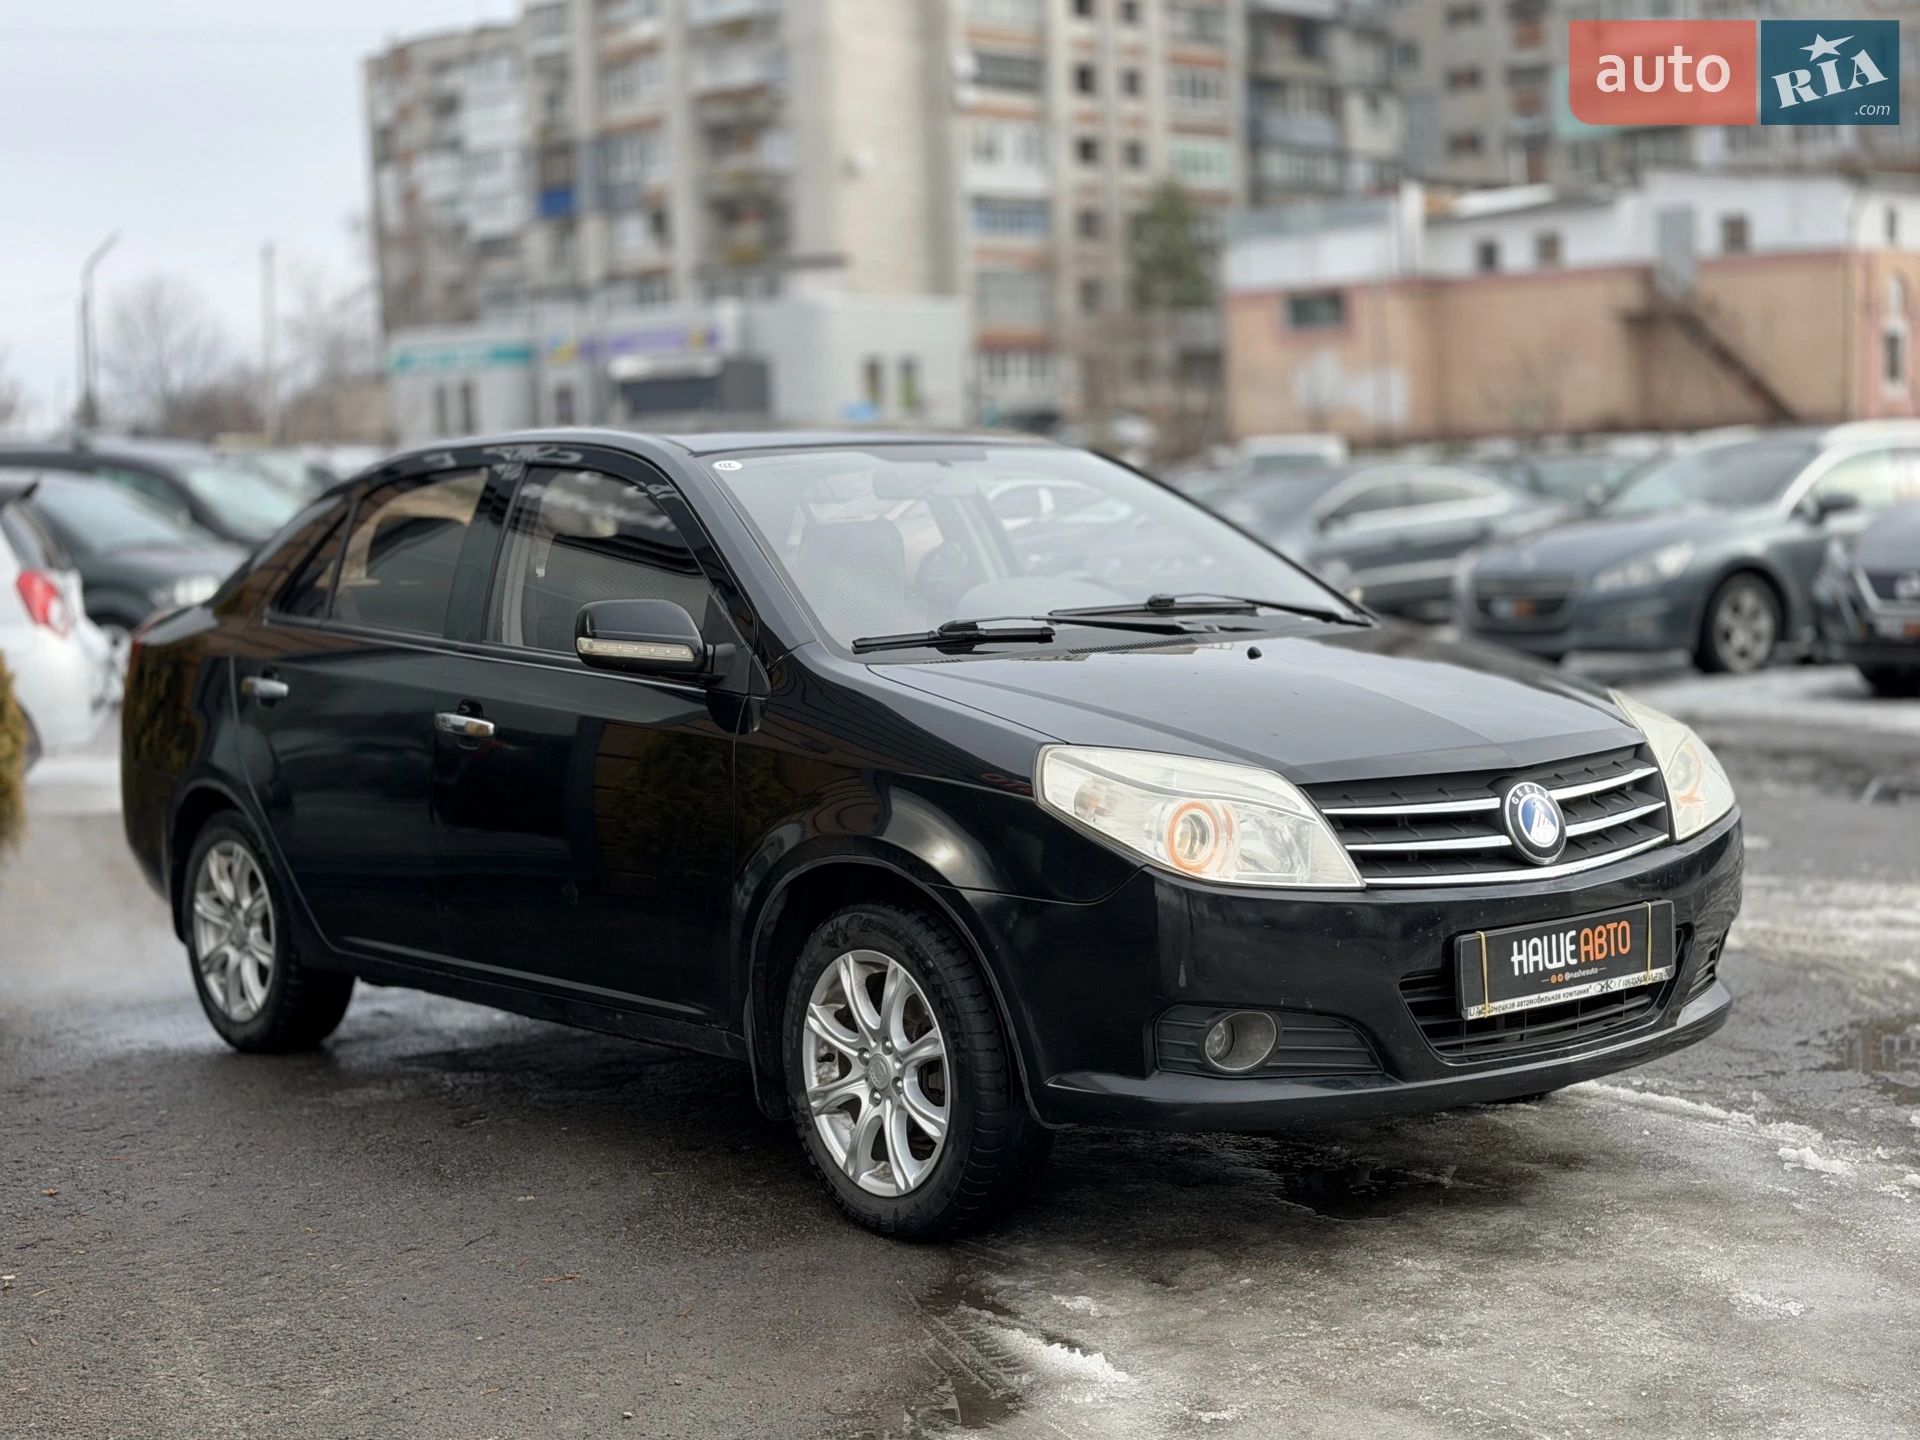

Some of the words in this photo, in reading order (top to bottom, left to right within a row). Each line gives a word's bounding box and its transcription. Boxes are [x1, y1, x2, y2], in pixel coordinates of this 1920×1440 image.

[1511, 785, 1550, 805] GEELY
[1511, 930, 1578, 977] НАШЕ
[1580, 920, 1631, 963] АВТО
[1564, 967, 1599, 981] @nasheauto
[1516, 995, 1561, 1008] автомобильная
